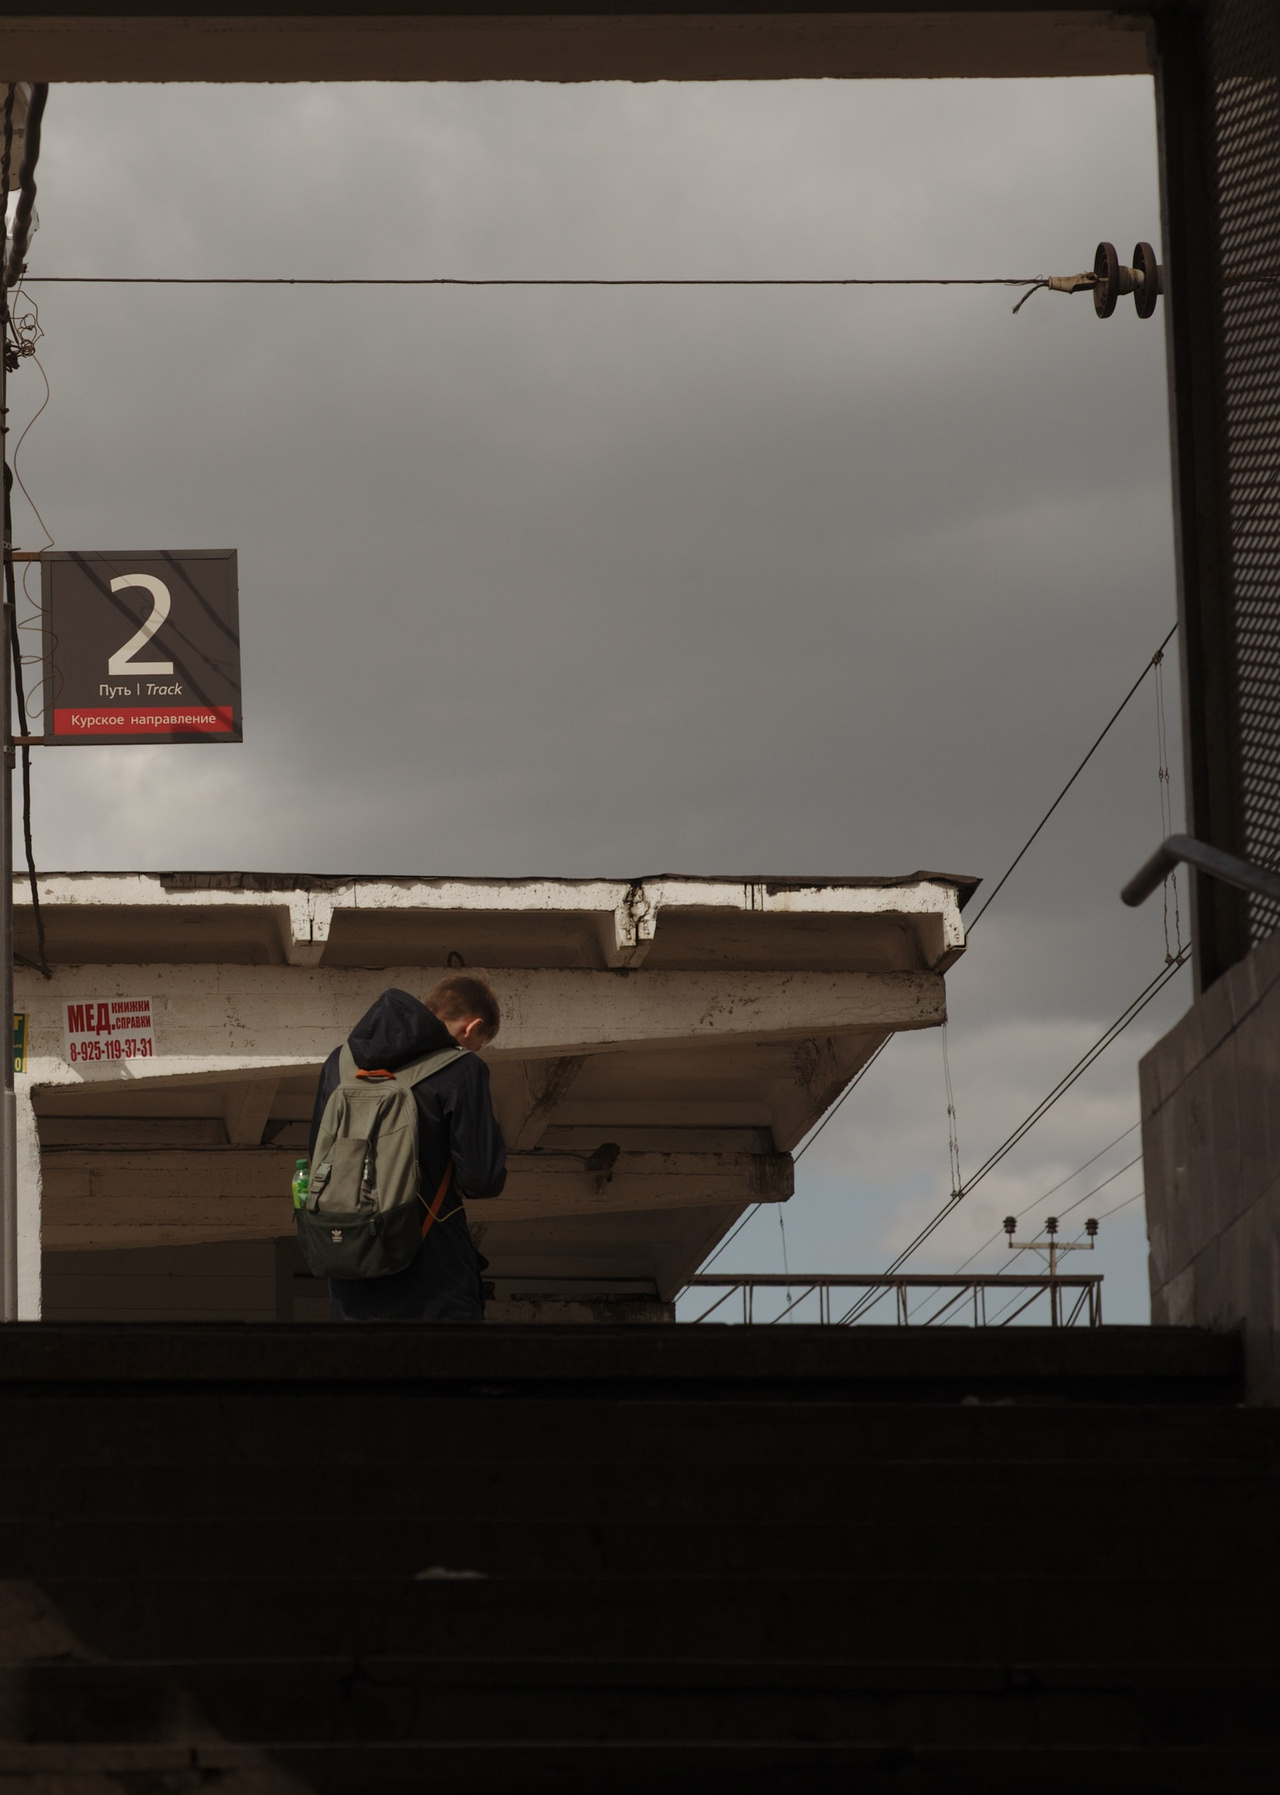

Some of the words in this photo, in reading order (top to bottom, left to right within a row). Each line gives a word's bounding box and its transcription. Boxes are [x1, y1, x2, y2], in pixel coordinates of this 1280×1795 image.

[108, 573, 174, 676] 2
[99, 684, 132, 699] Путь
[146, 683, 183, 696] Track
[71, 714, 125, 728] Курское
[130, 714, 217, 728] направление
[111, 1000, 150, 1014] КНИЖКИ
[115, 1015, 151, 1030] СПРАВКИ
[70, 1038, 153, 1062] 8-925-119-37-31
